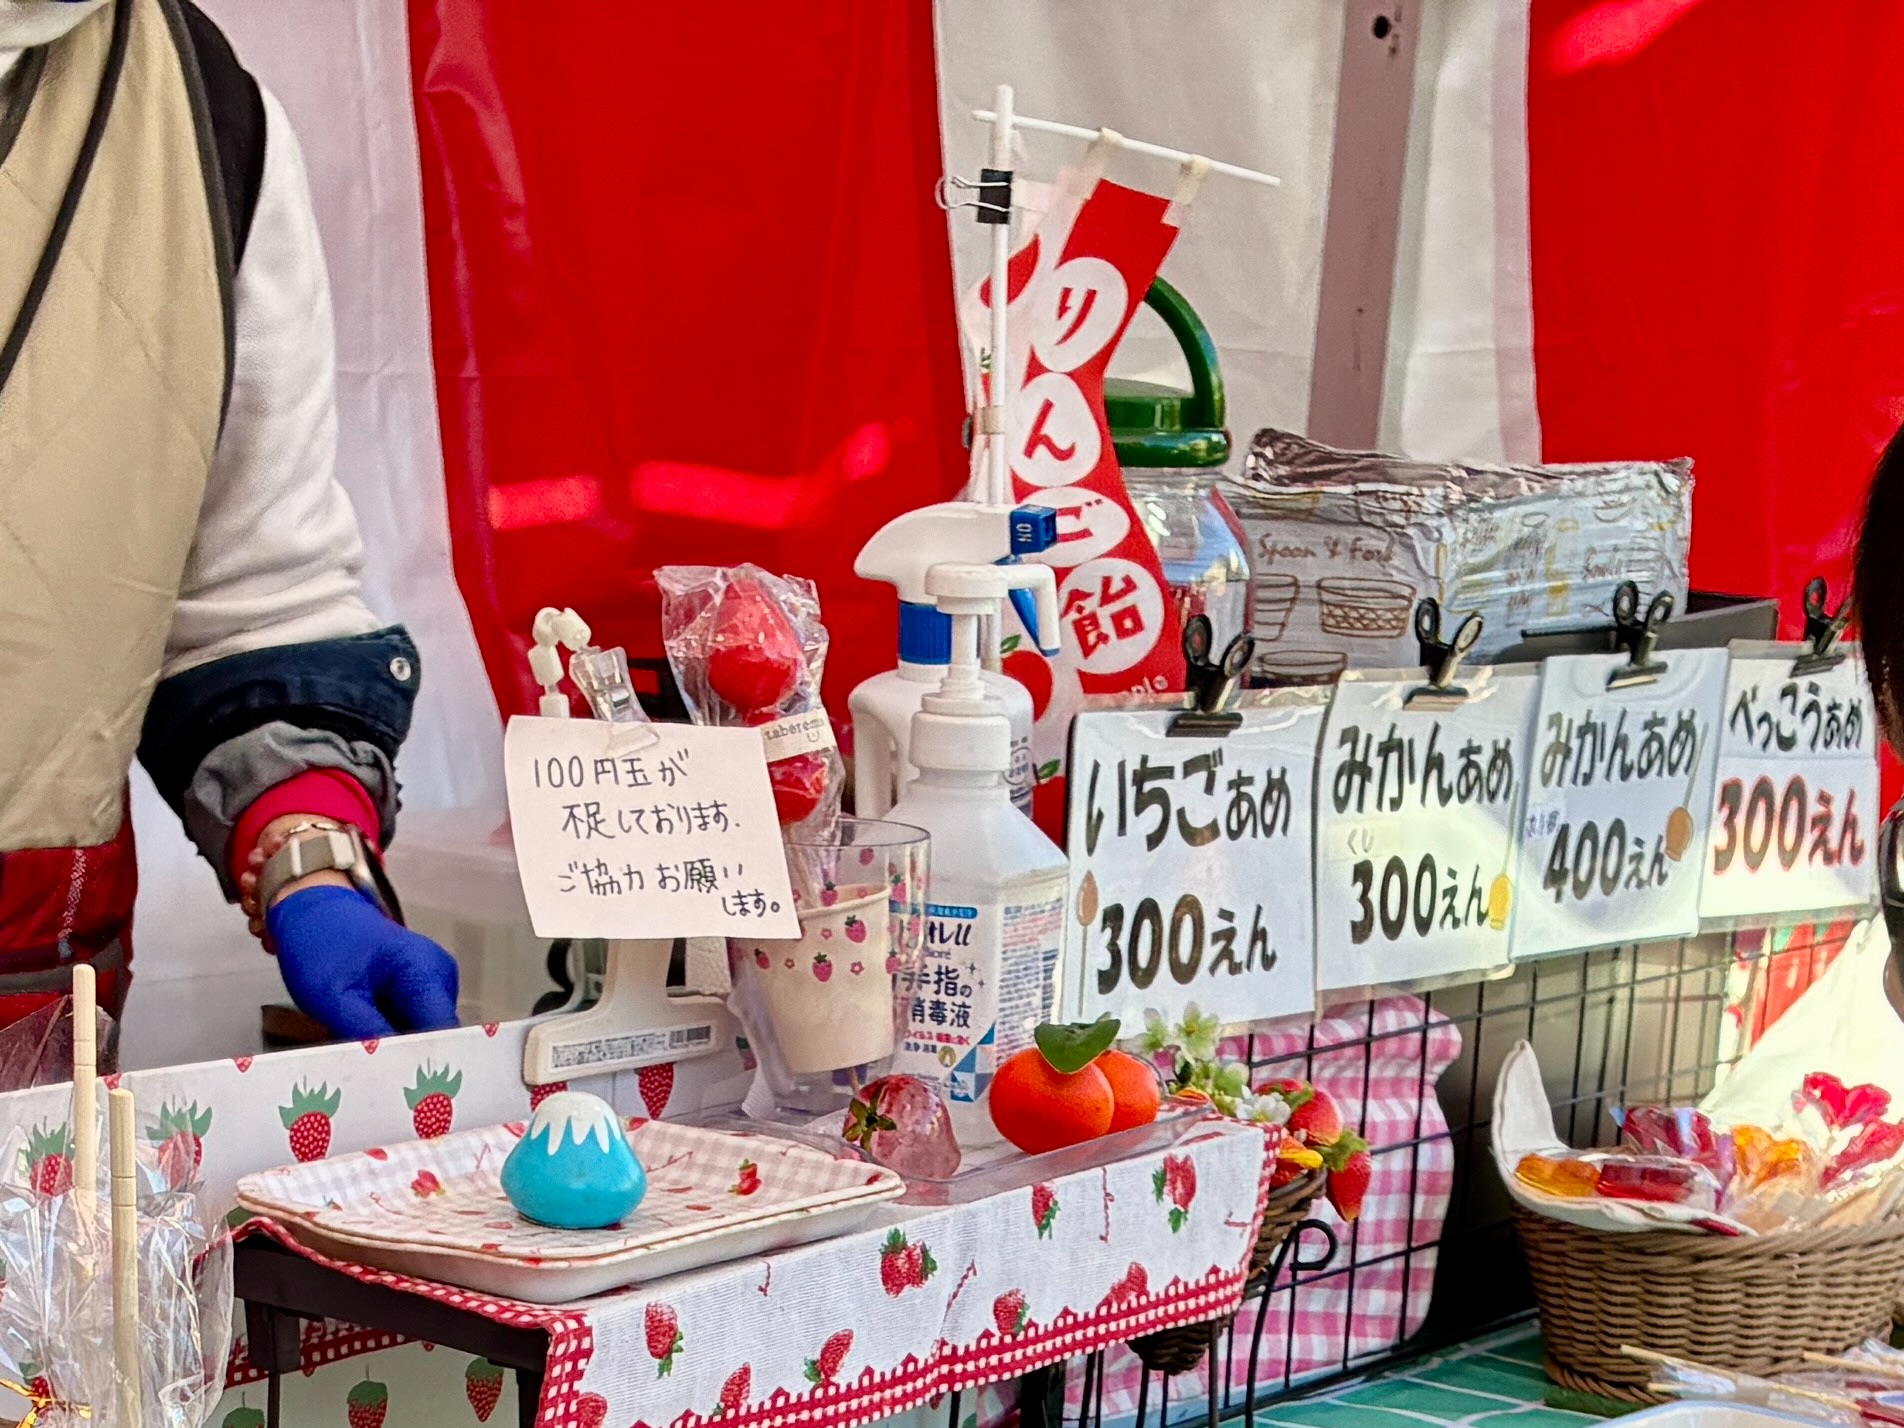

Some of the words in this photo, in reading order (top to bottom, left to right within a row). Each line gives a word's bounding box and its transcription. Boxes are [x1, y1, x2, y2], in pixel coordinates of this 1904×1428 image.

[1023, 287, 1146, 660] りんご飴
[1544, 706, 1696, 789] みかんあめ
[1729, 684, 1865, 755] べっこうあめ
[534, 748, 690, 789] 100円玉が
[1084, 749, 1292, 856] いちごあめ
[1333, 722, 1516, 814] みかんあめ
[1542, 817, 1670, 908] 400えん
[1711, 773, 1866, 876] 300えん
[1097, 893, 1277, 996] 300えん
[1349, 854, 1492, 946] 300えん
